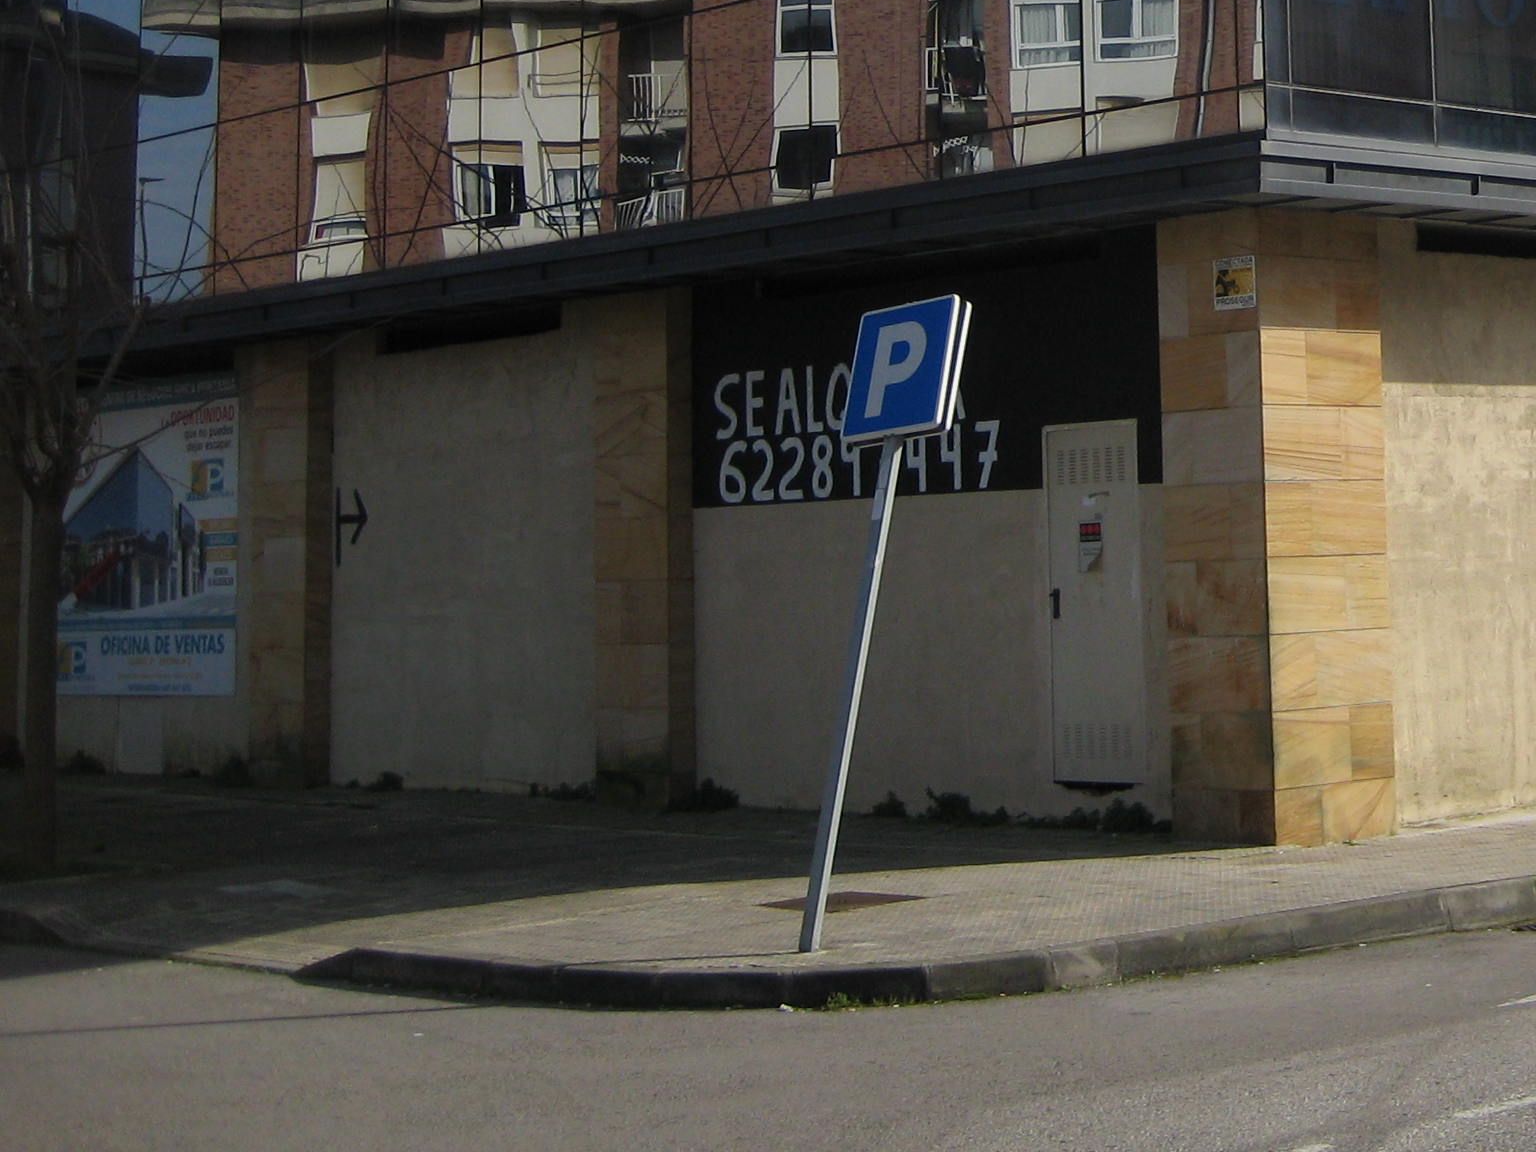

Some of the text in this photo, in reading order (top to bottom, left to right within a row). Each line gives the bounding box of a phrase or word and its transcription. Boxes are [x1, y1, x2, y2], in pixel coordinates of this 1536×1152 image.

[714, 369, 765, 440] SE
[864, 321, 928, 418] P
[100, 633, 225, 655] OFICINA DE VENTAS
